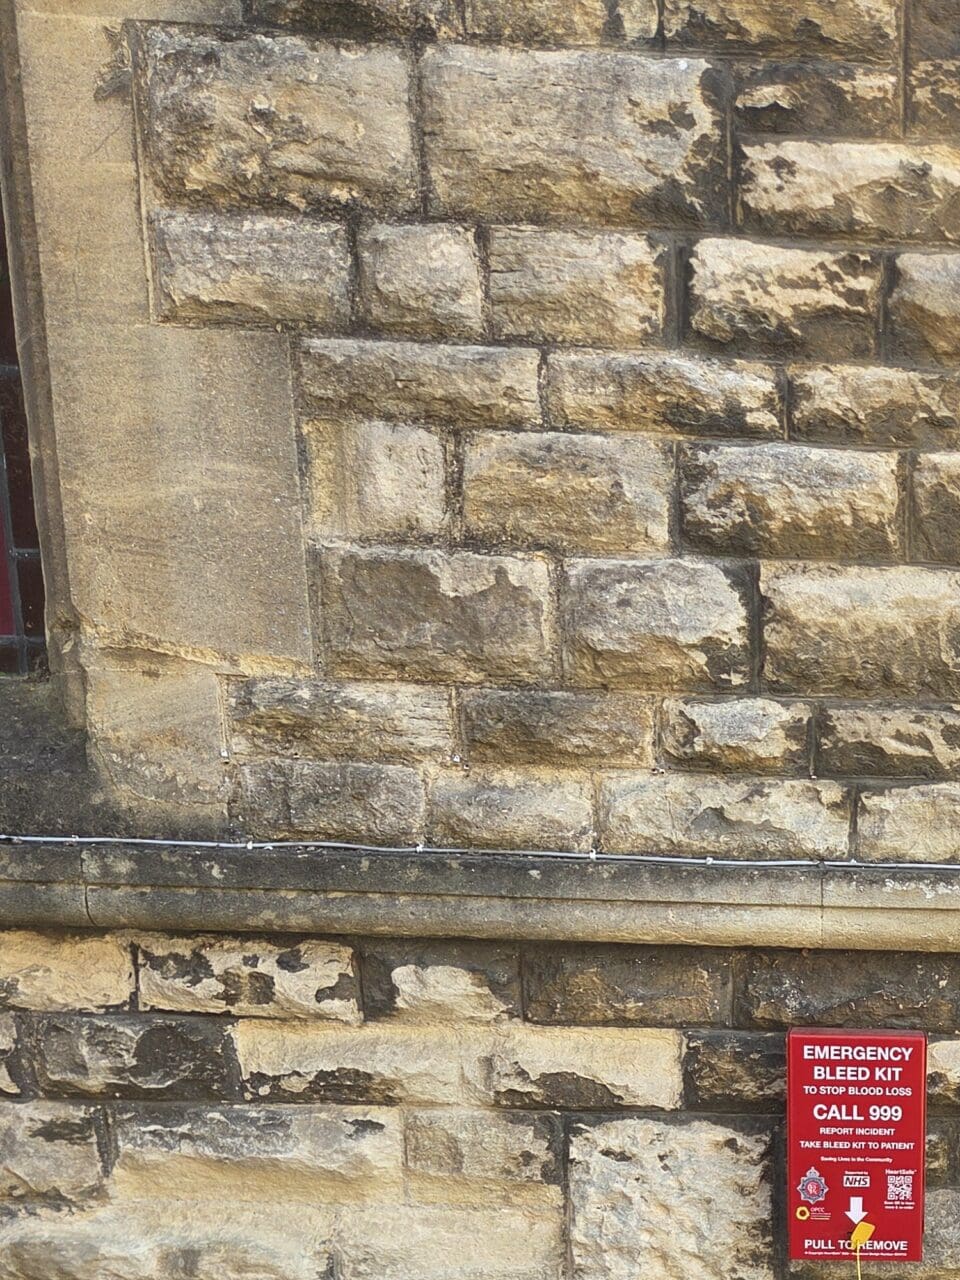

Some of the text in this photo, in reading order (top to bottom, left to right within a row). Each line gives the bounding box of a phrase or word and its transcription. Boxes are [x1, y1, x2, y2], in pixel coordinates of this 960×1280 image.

[803, 1045, 913, 1061] EMERGENCY
[813, 1066, 903, 1082] BLEED KIT
[803, 1085, 912, 1097] TO STOP BLOOD LOSS
[813, 1104, 903, 1121] CALL 999
[819, 1127, 895, 1136] REPORT INCIDENT
[799, 1140, 915, 1150] TAKE BLEED KIT TO PATIENT
[845, 1176, 869, 1186] NHS
[804, 1239, 835, 1249] PULL
[838, 1240, 855, 1250] TO
